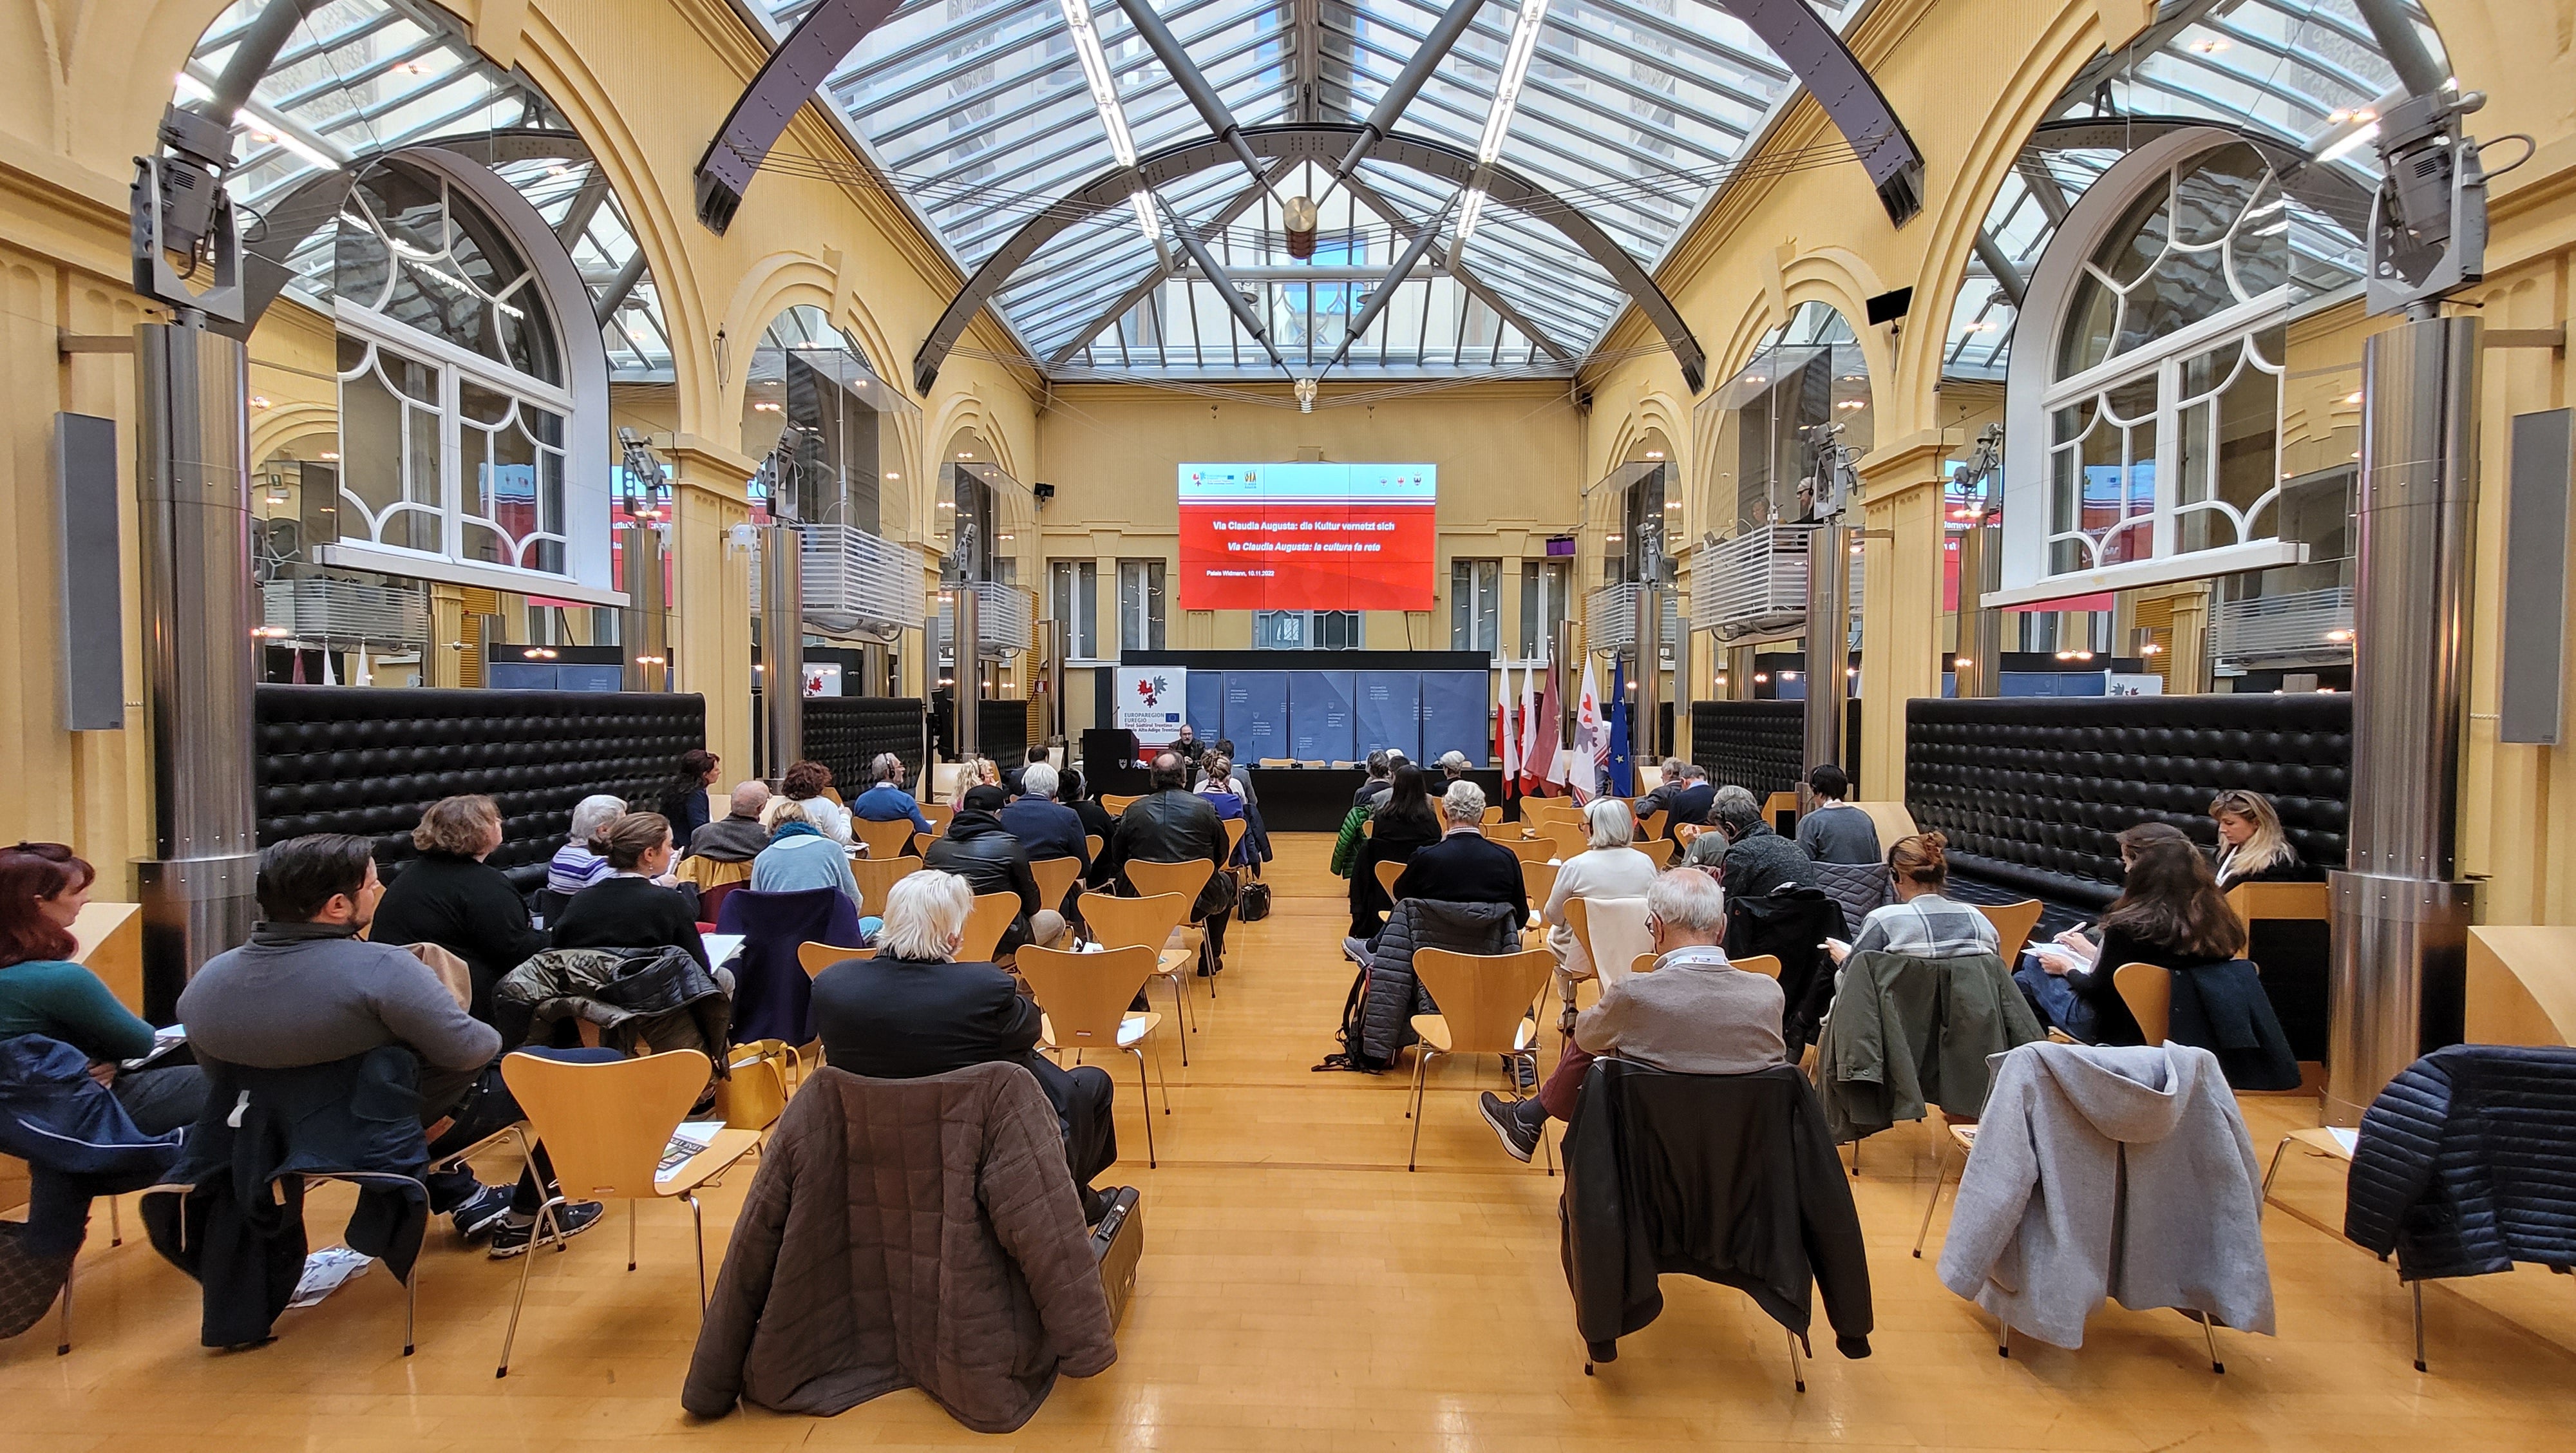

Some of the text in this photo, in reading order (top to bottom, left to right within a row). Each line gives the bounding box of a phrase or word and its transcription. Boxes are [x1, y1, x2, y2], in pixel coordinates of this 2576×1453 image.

[1213, 522, 1226, 530] Via
[1227, 522, 1259, 530] Claudia
[1260, 522, 1298, 532] Augusta:
[1314, 522, 1341, 530] Kultur
[1376, 522, 1395, 531] sich
[1227, 542, 1241, 551] Via
[1242, 542, 1274, 551] Claudia
[1274, 542, 1312, 553] Augusta:
[1313, 542, 1322, 551] la
[1323, 542, 1353, 551] cultura
[1354, 542, 1363, 551] fa
